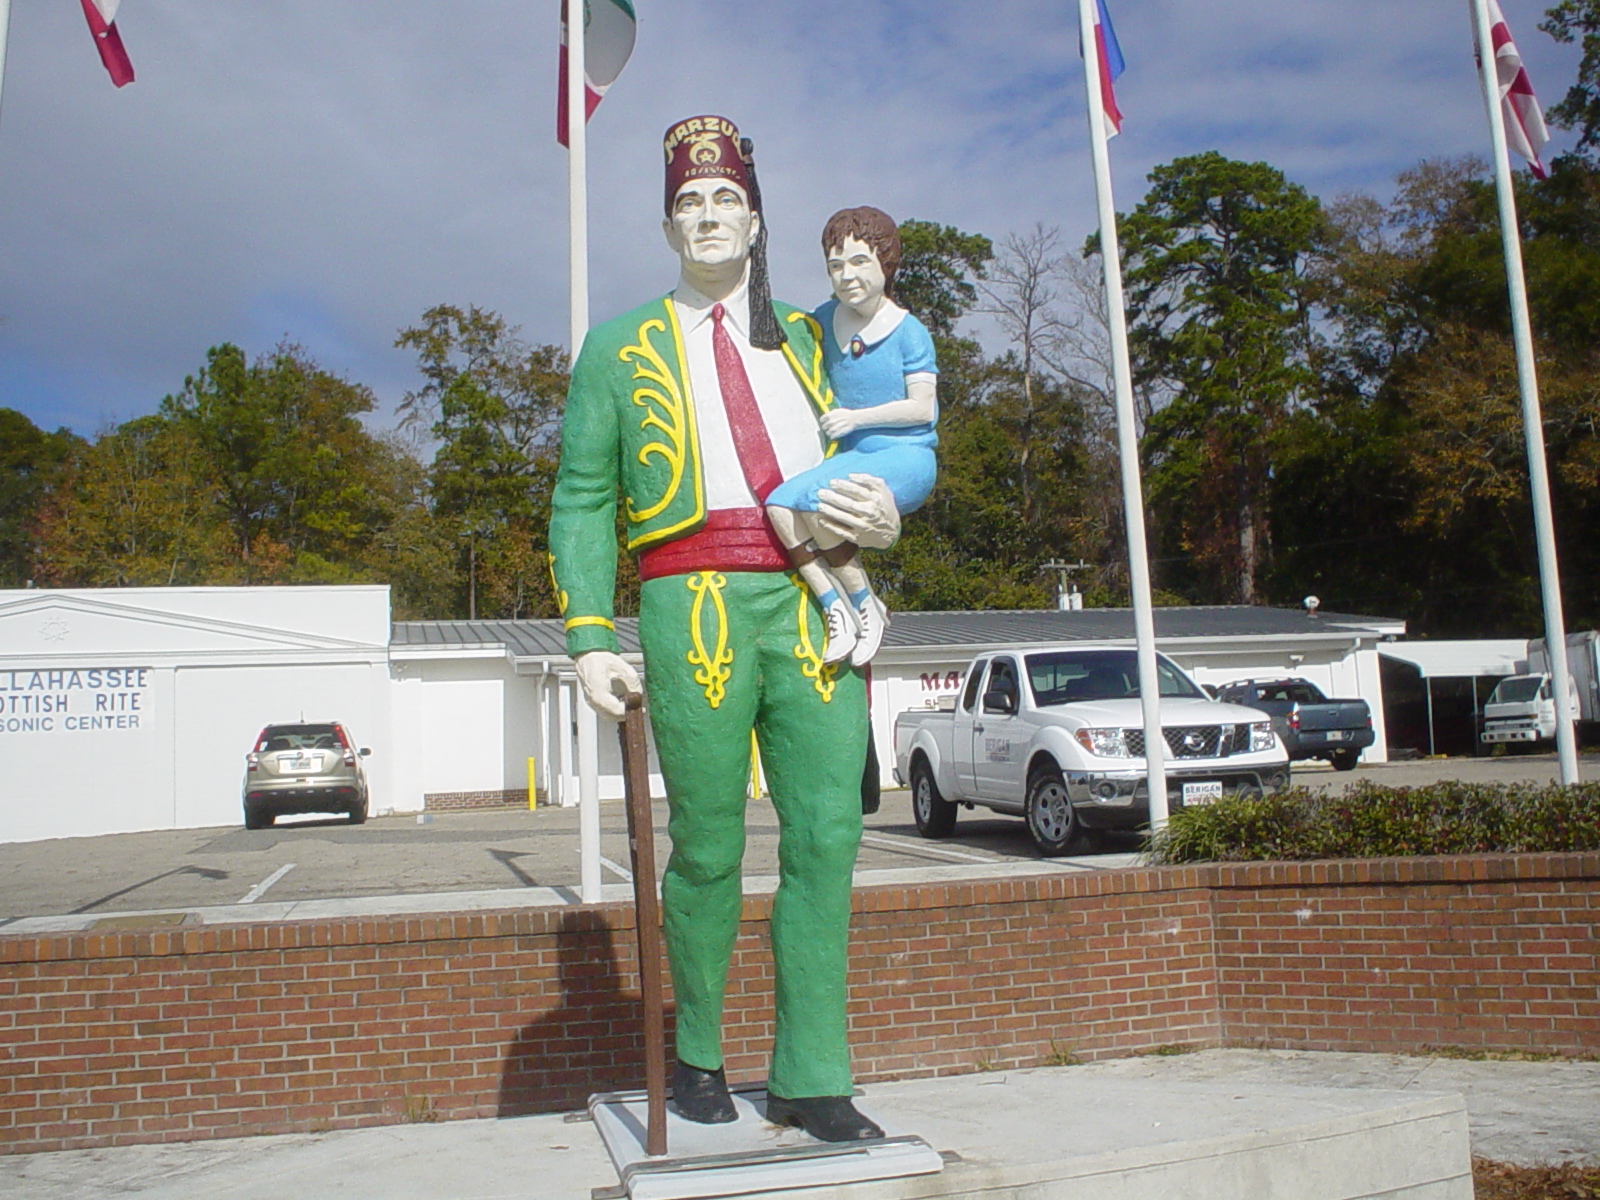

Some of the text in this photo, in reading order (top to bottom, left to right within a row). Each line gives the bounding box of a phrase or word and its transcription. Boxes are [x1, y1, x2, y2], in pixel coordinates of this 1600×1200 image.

[919, 671, 967, 691] MA
[95, 692, 141, 712] RITE
[64, 715, 140, 731] CENTER
